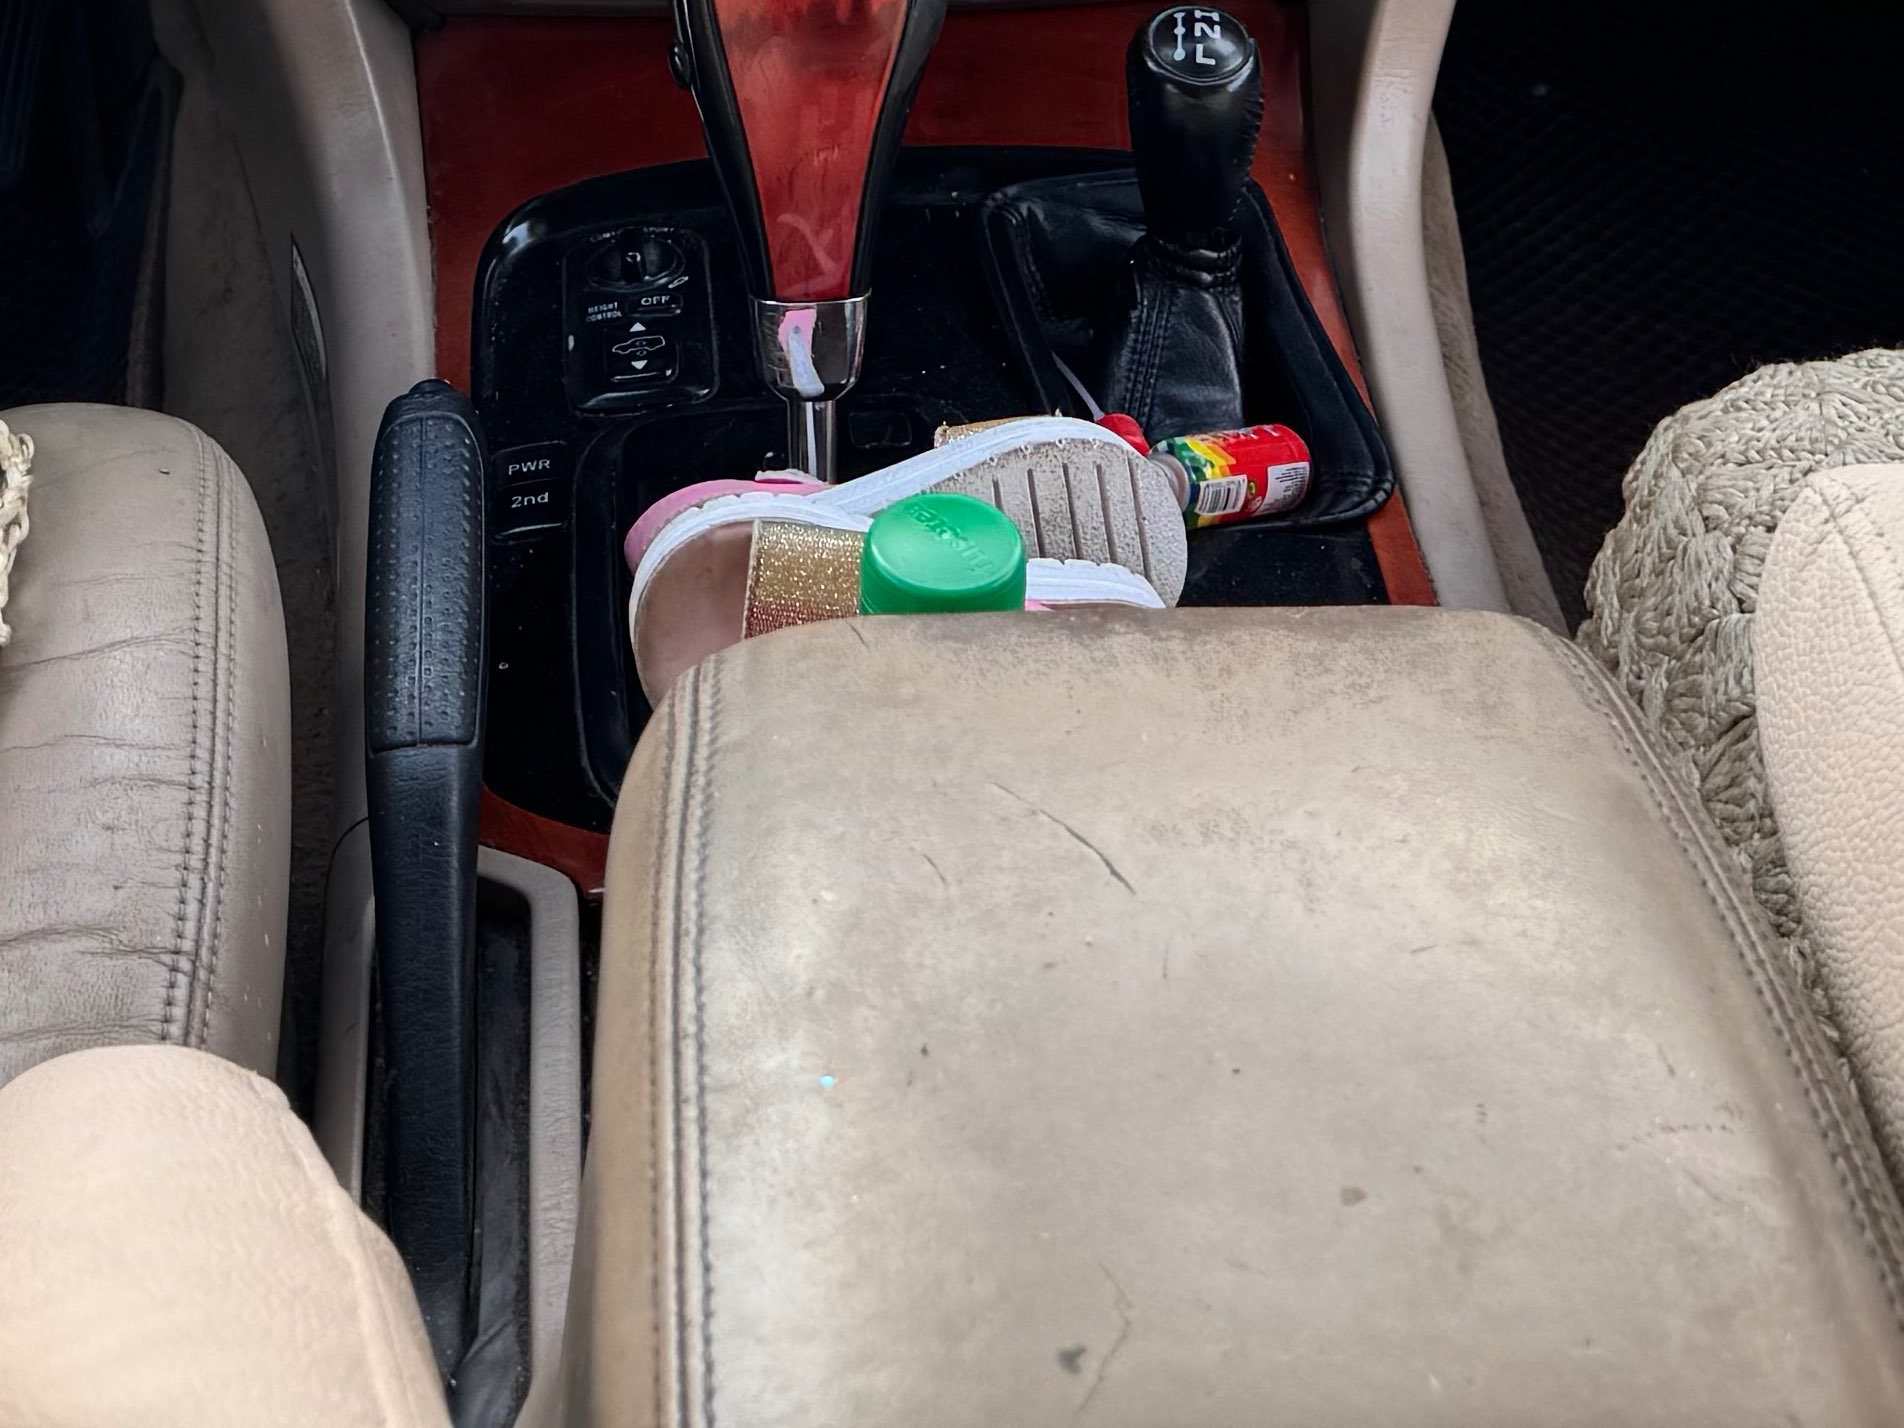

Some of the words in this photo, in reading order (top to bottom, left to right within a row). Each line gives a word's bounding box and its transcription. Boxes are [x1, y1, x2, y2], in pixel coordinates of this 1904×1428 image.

[1194, 22, 1221, 39] N
[1195, 43, 1217, 66] L
[640, 295, 671, 306] OFF
[507, 459, 551, 476] PWR
[511, 492, 549, 508] 2nd
